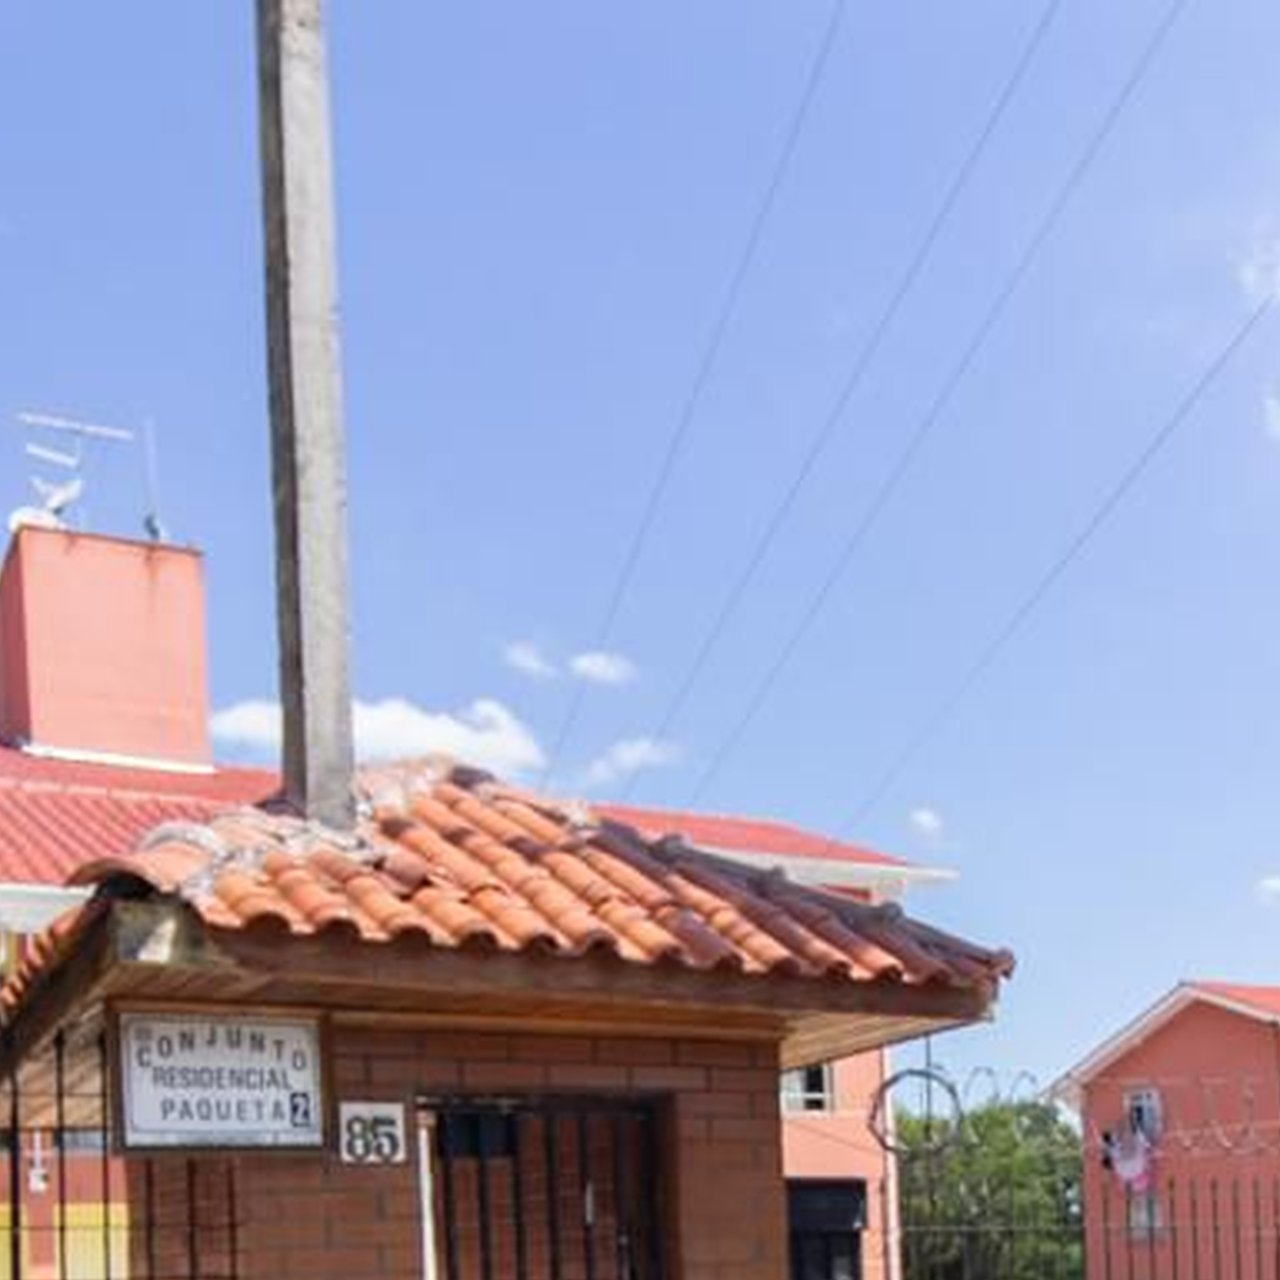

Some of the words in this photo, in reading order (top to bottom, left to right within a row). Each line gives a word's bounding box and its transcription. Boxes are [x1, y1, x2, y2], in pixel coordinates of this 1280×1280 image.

[136, 1026, 308, 1071] CONJUNTO
[152, 1066, 293, 1092] RESIDENCIAL
[346, 1115, 400, 1164] 85
